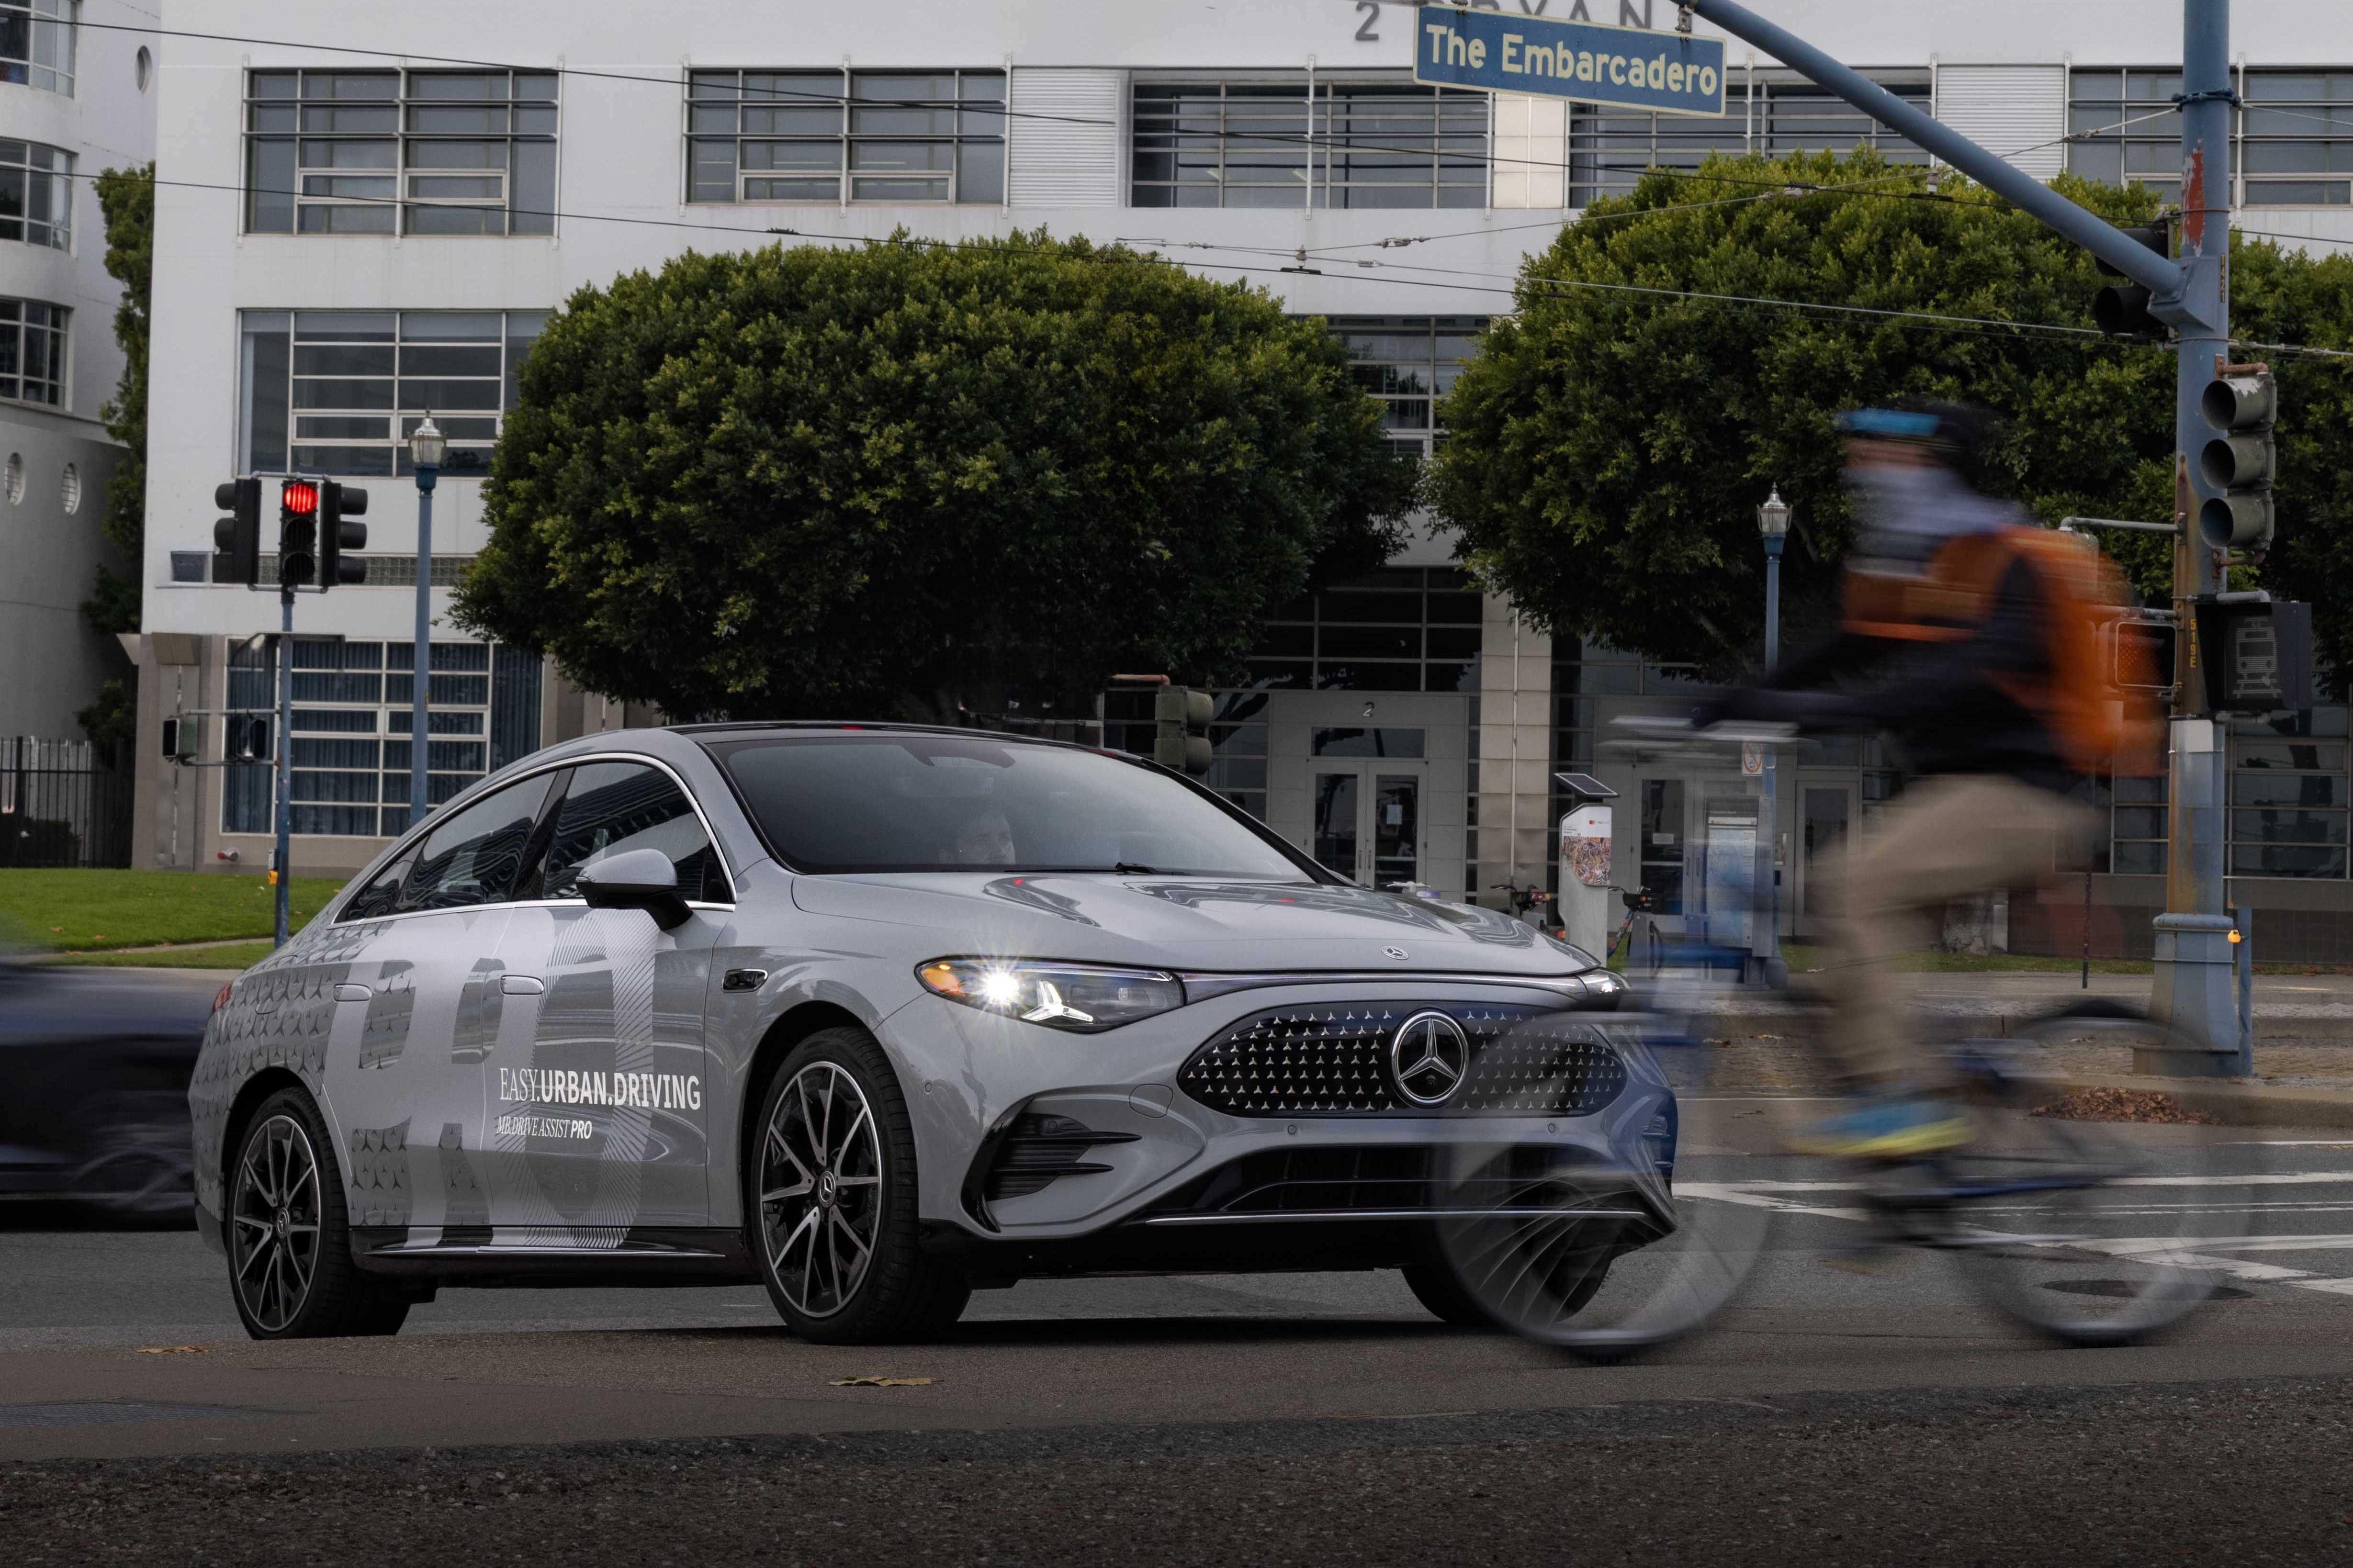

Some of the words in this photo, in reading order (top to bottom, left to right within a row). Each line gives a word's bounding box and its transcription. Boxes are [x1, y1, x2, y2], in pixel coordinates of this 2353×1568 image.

[1354, 1, 1379, 41] 2
[1427, 25, 1486, 68] The
[1502, 34, 1717, 95] Embarcadero
[1363, 702, 1374, 717] 2
[499, 1067, 701, 1110] EASY.URBAN.DRIVING
[496, 1116, 539, 1136] MB.DRIVE
[538, 1118, 570, 1138] ASSIST
[570, 1120, 593, 1139] PRO
